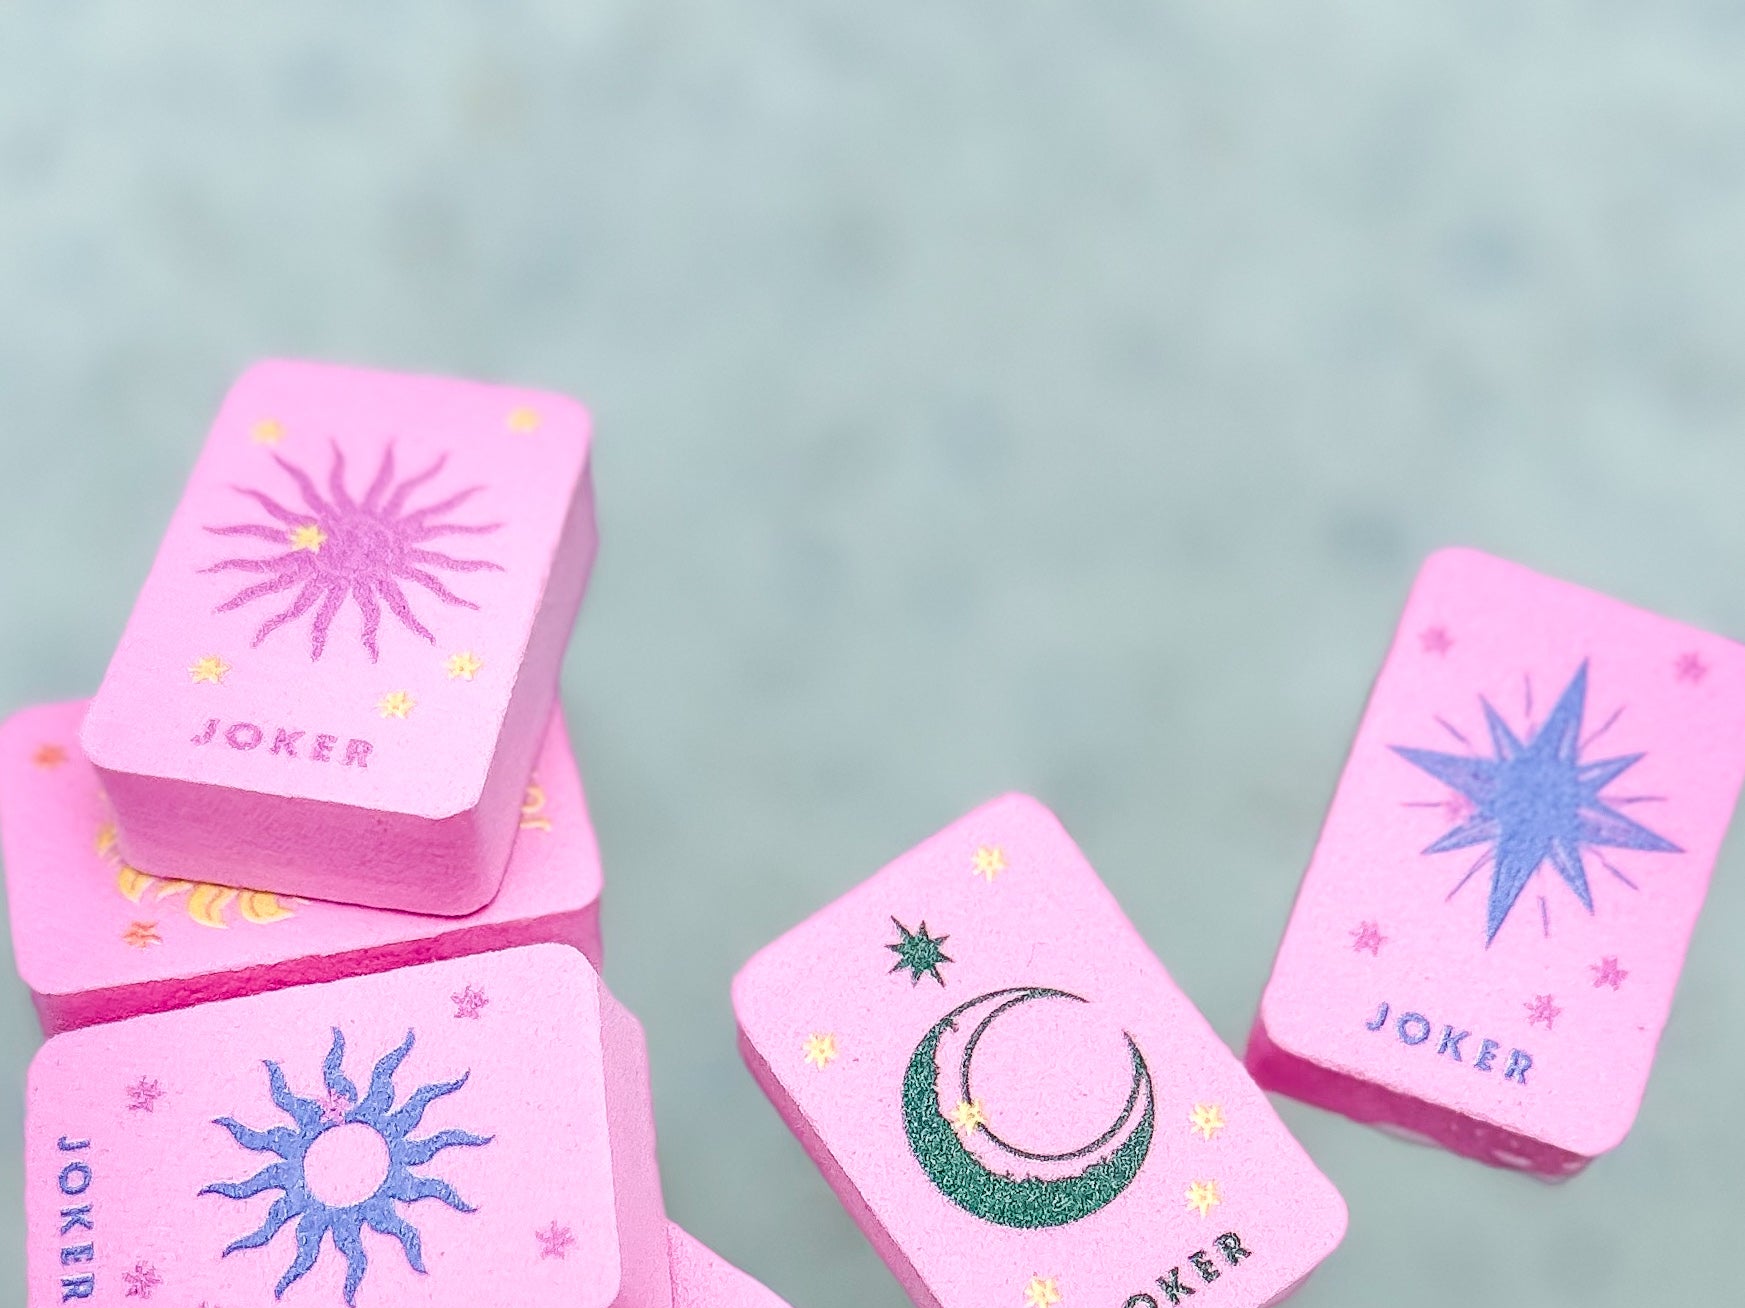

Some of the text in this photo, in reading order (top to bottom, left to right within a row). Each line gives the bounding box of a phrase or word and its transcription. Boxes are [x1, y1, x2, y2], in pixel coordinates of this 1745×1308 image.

[190, 718, 374, 768] JOKER
[1366, 1001, 1532, 1084] JOKER
[57, 1135, 95, 1303] JOKER
